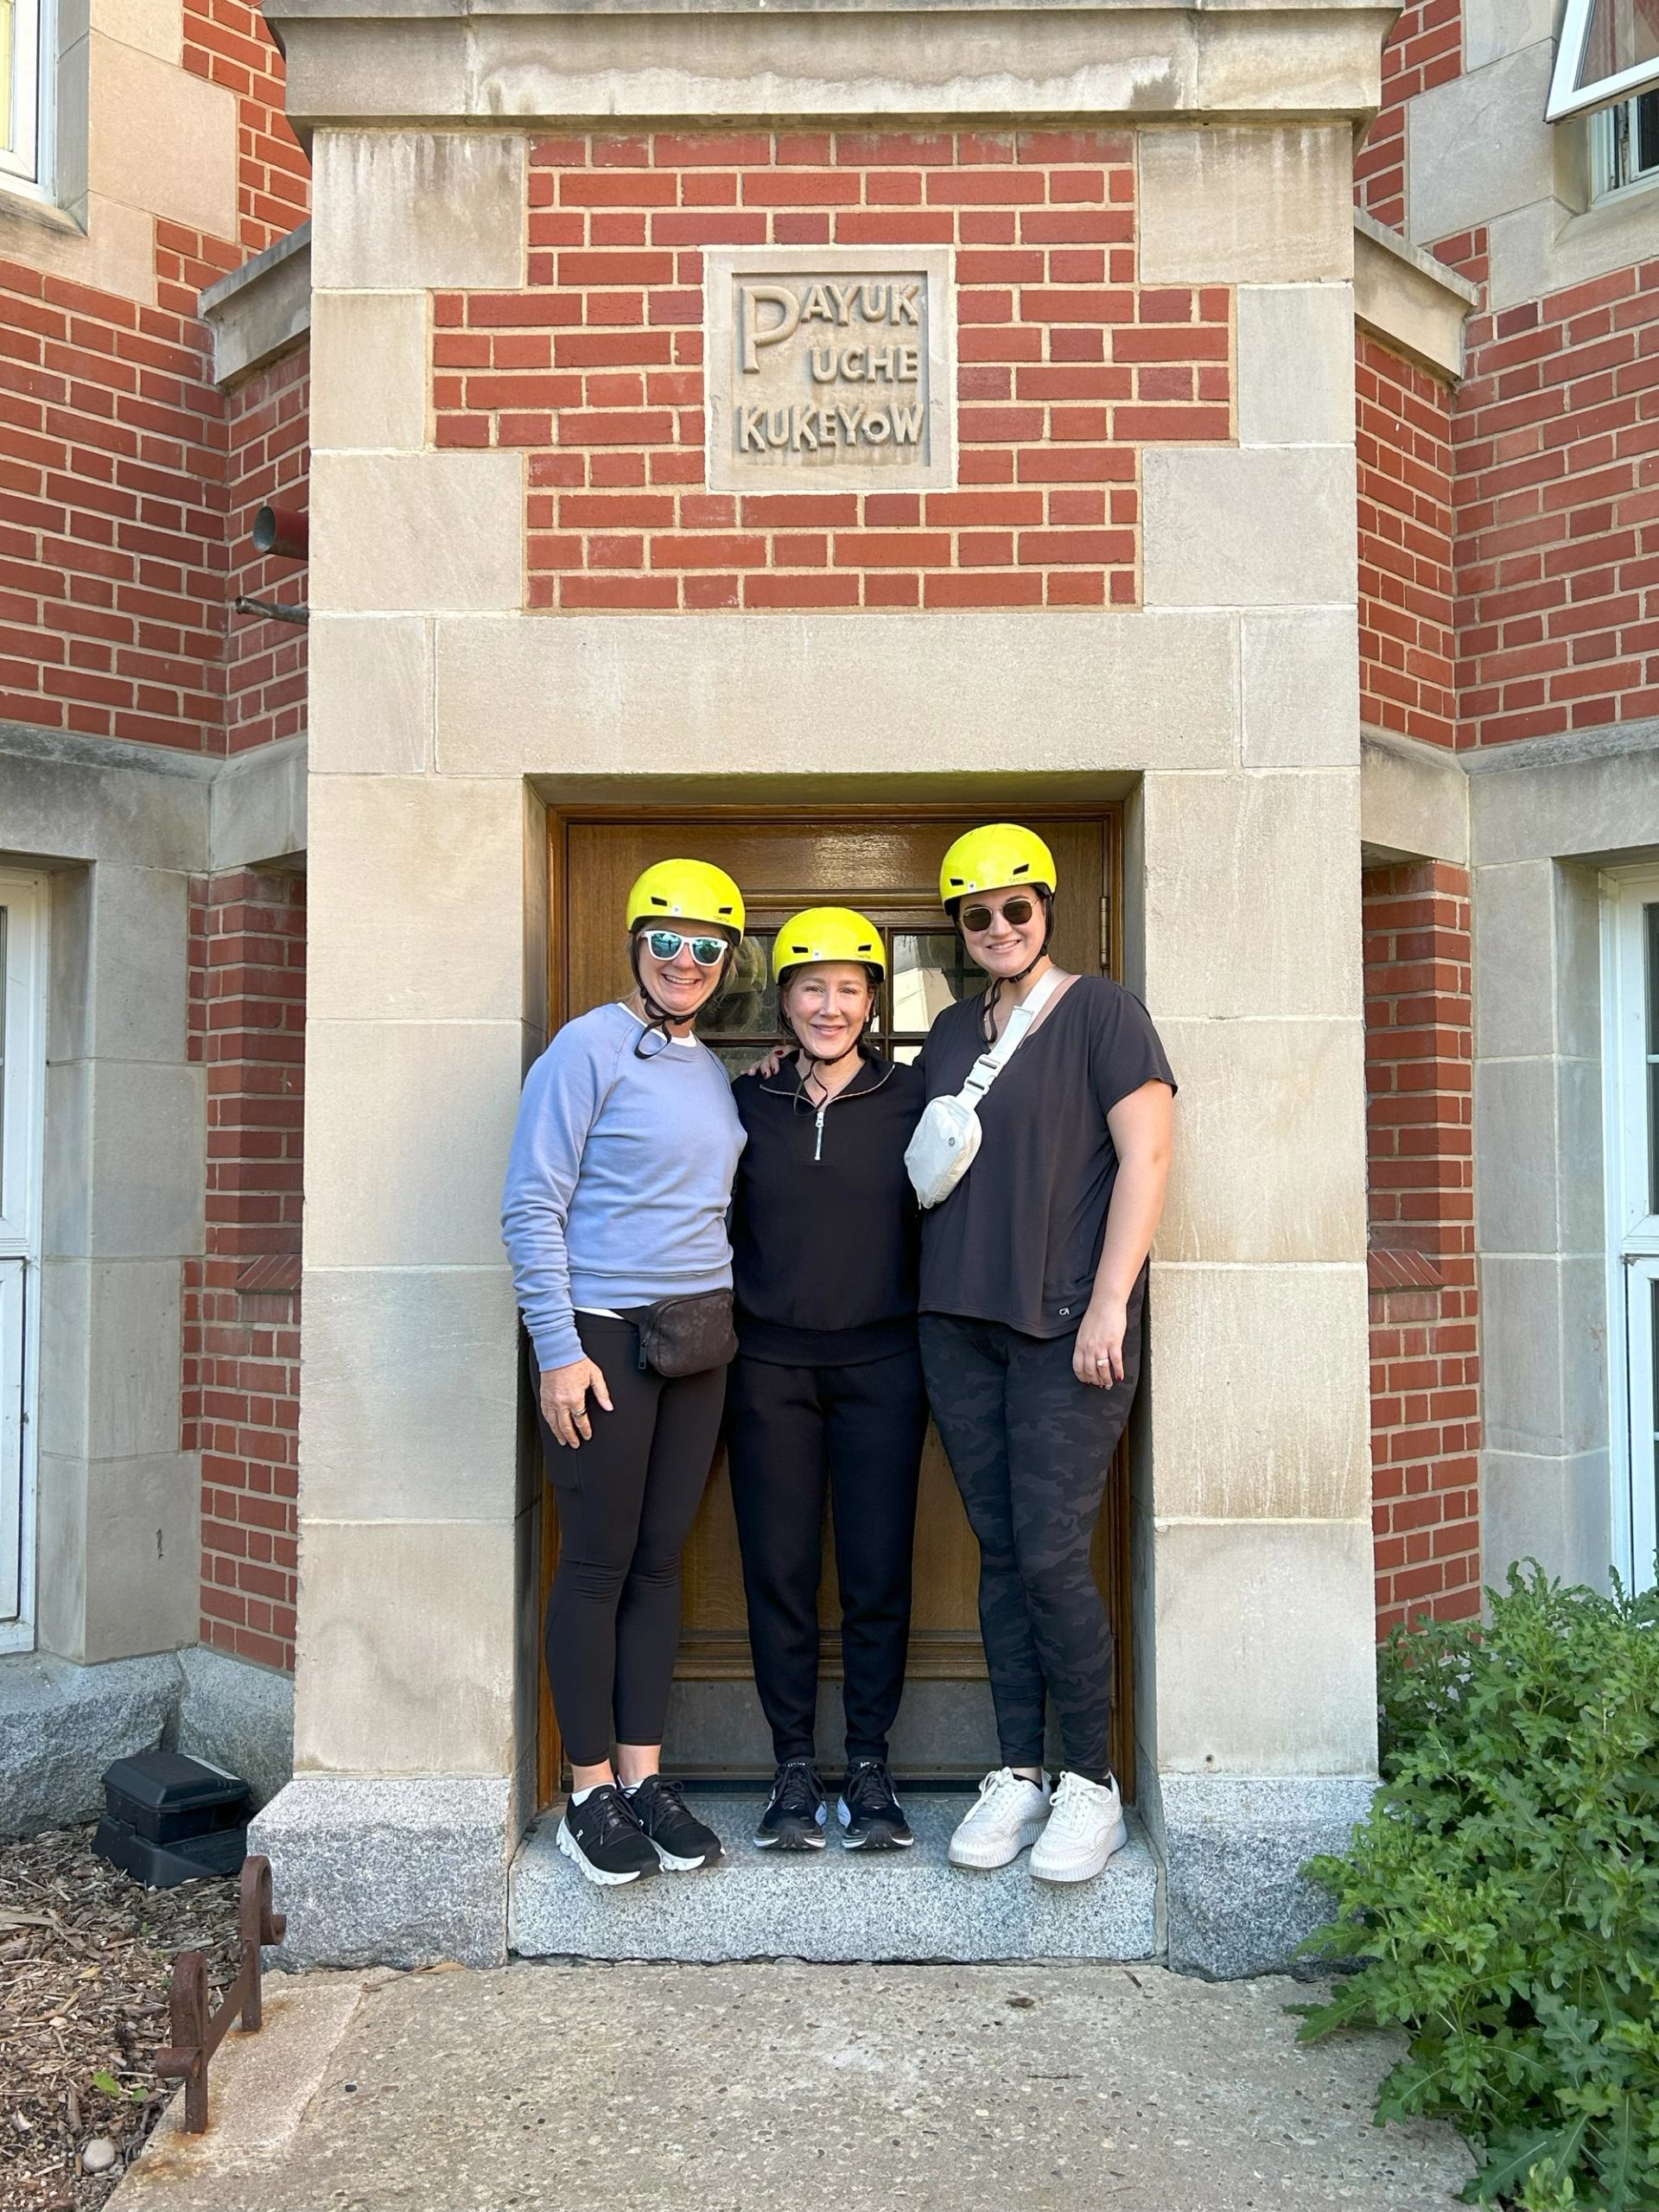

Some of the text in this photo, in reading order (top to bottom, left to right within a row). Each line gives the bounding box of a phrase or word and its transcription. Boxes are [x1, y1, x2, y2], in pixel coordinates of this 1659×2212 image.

[741, 283, 919, 374] PAYUK
[809, 346, 918, 383] UCHE
[739, 402, 925, 453] KUKEYOW
